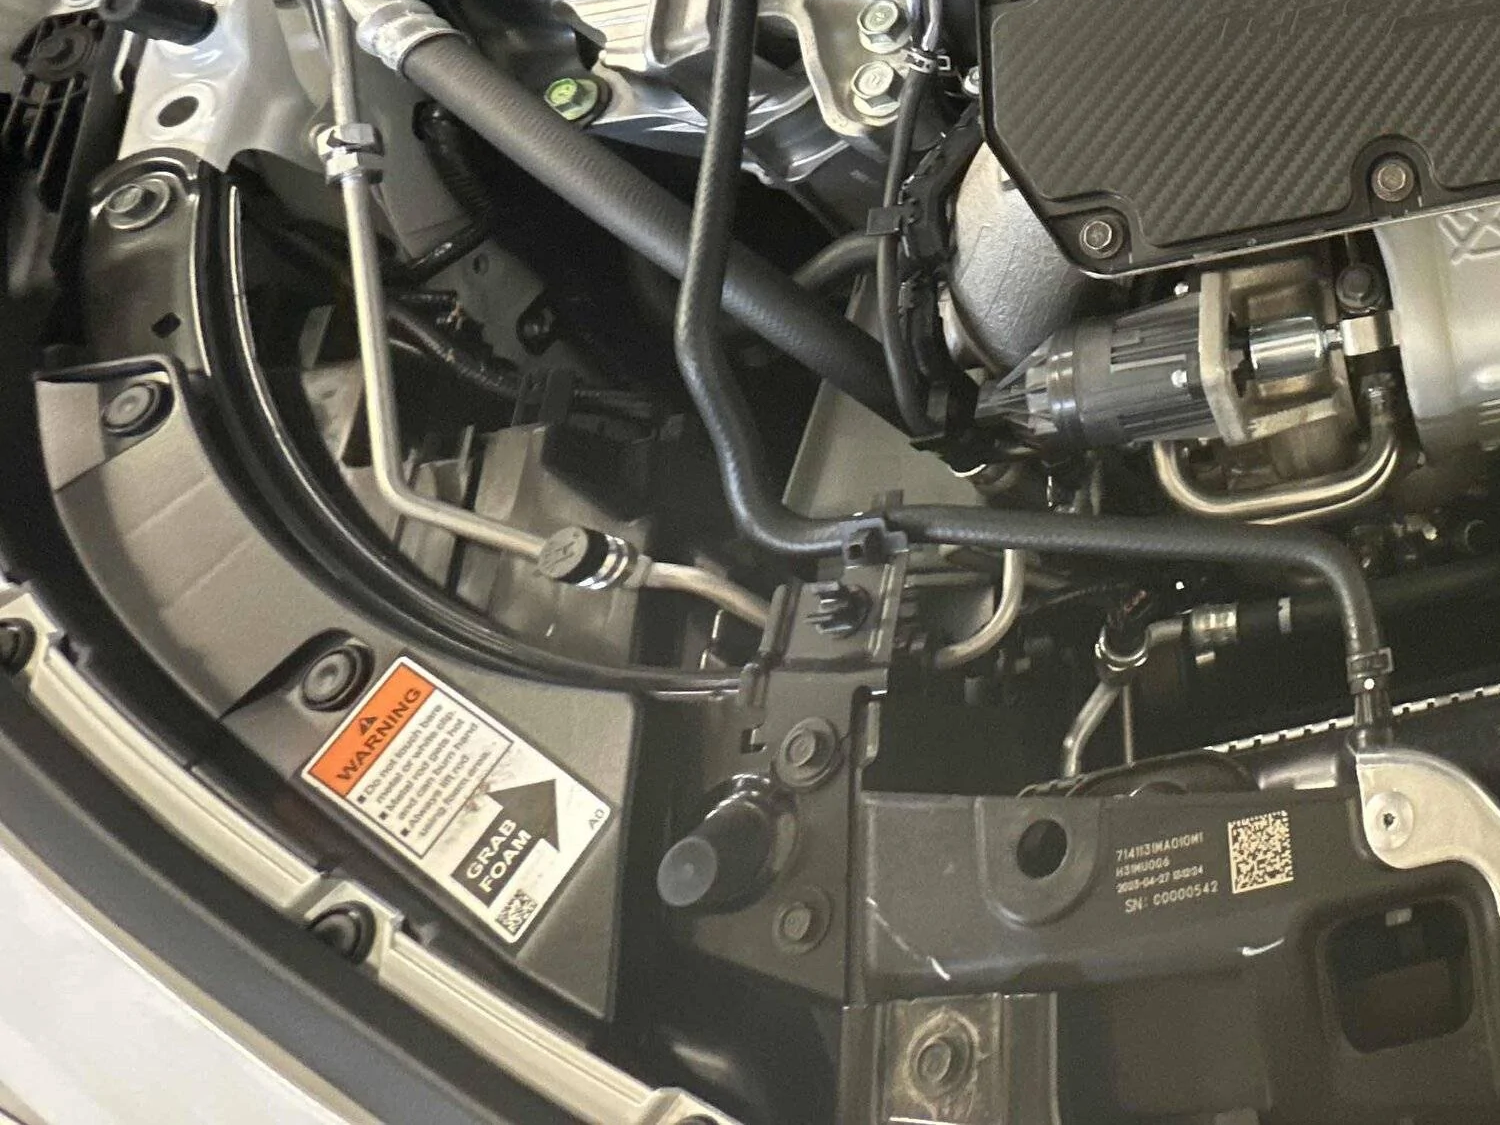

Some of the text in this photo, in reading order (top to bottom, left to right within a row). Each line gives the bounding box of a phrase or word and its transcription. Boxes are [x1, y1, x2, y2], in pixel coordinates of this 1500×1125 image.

[337, 687, 422, 782] WARNING
[363, 701, 444, 796] Do not touch bare
[374, 771, 404, 804] metal
[400, 758, 415, 774] or
[410, 728, 439, 761] white
[384, 717, 465, 812] Metal rod gets hot
[396, 796, 418, 821] and
[414, 775, 435, 798] can
[431, 749, 456, 776] burn
[407, 753, 470, 828] Always lift rod
[417, 804, 447, 839] using
[441, 775, 469, 806] foam
[465, 817, 519, 880] GRAB
[478, 829, 532, 893] FOAM
